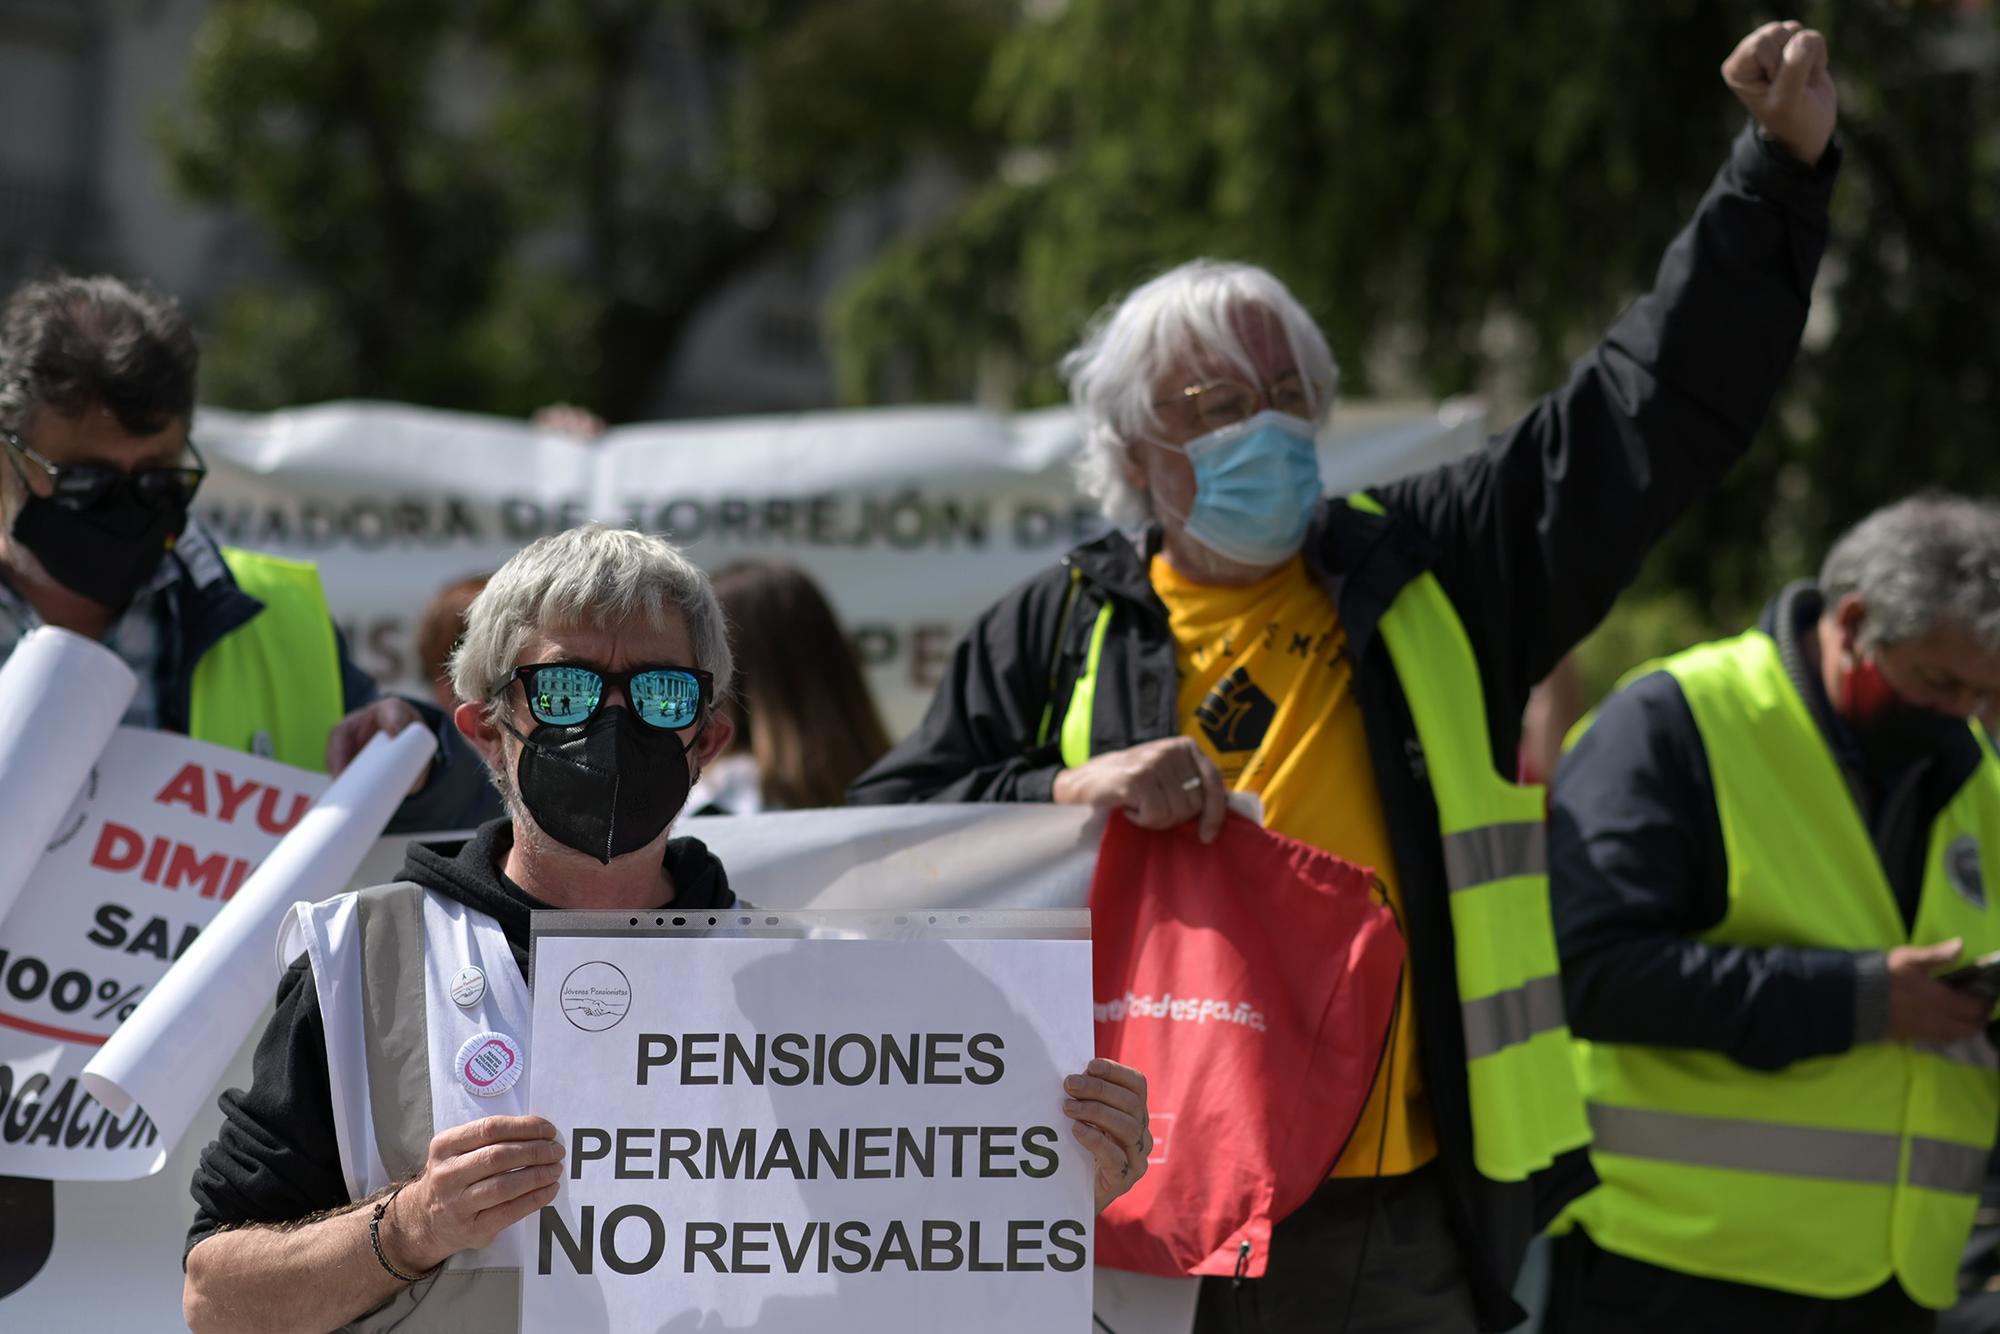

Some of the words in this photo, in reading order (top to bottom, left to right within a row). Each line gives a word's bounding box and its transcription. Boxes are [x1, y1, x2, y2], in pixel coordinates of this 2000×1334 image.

[205, 496, 483, 550] NADORA
[154, 761, 311, 837] AYU
[90, 820, 256, 902] DIMI
[590, 986, 628, 996] Pensionistas
[636, 1032, 1006, 1086] PENSIONES
[570, 1125, 1059, 1180] PERMANENTES
[538, 1204, 666, 1275] NO
[683, 1219, 1086, 1274] REVISABLES
